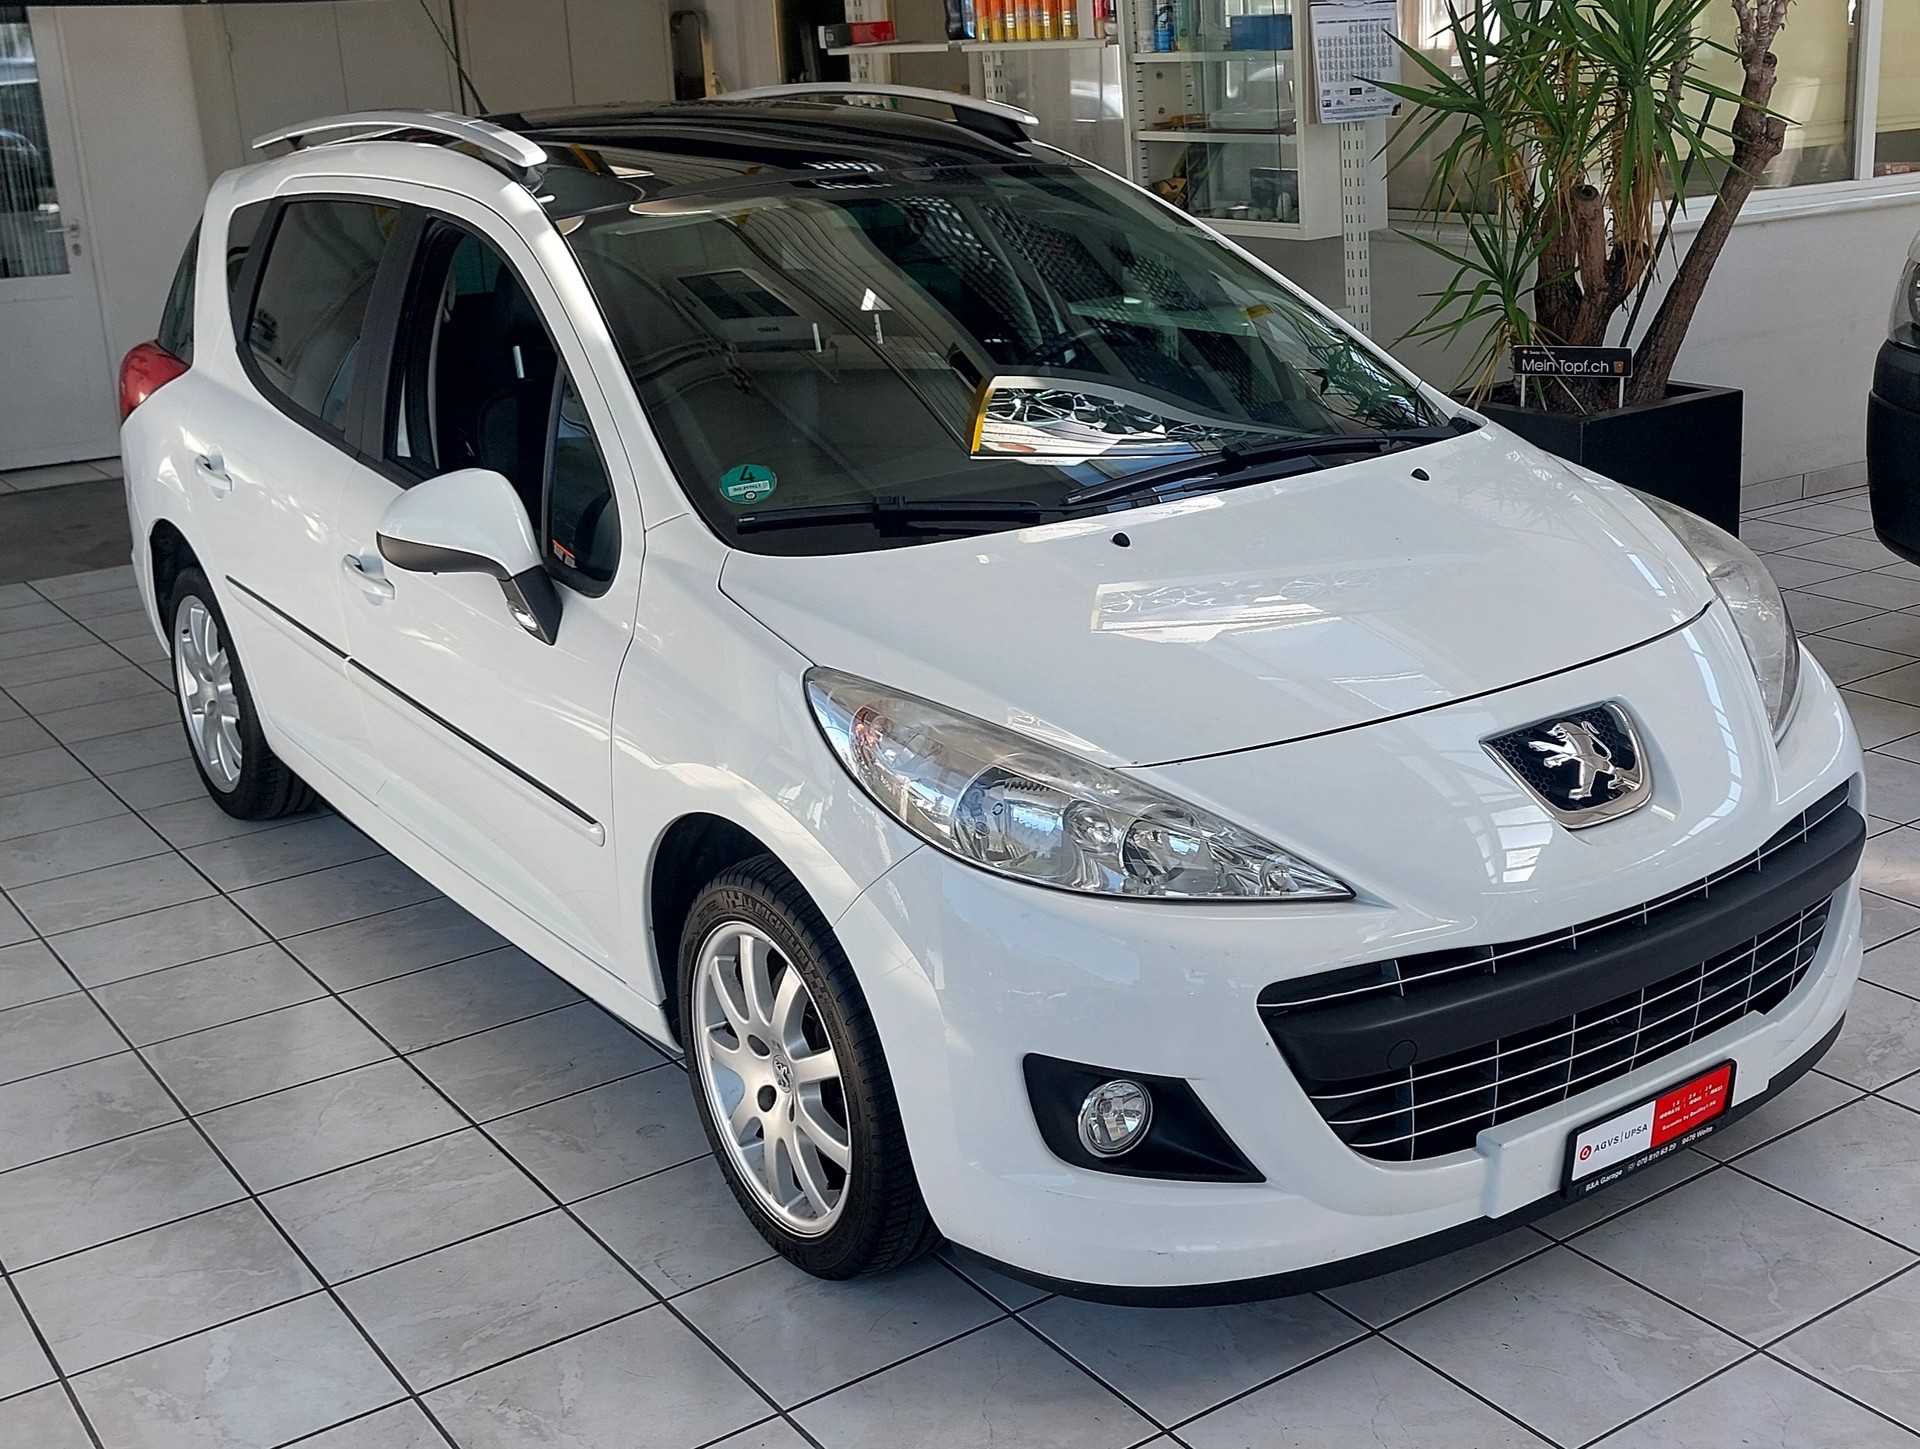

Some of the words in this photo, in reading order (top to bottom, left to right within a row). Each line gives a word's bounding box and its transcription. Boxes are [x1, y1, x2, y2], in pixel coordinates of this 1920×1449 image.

[1522, 359, 1555, 372] Mein
[1559, 359, 1609, 374] Topf.ch
[740, 466, 756, 482] 4
[754, 902, 809, 967] MICHELIN
